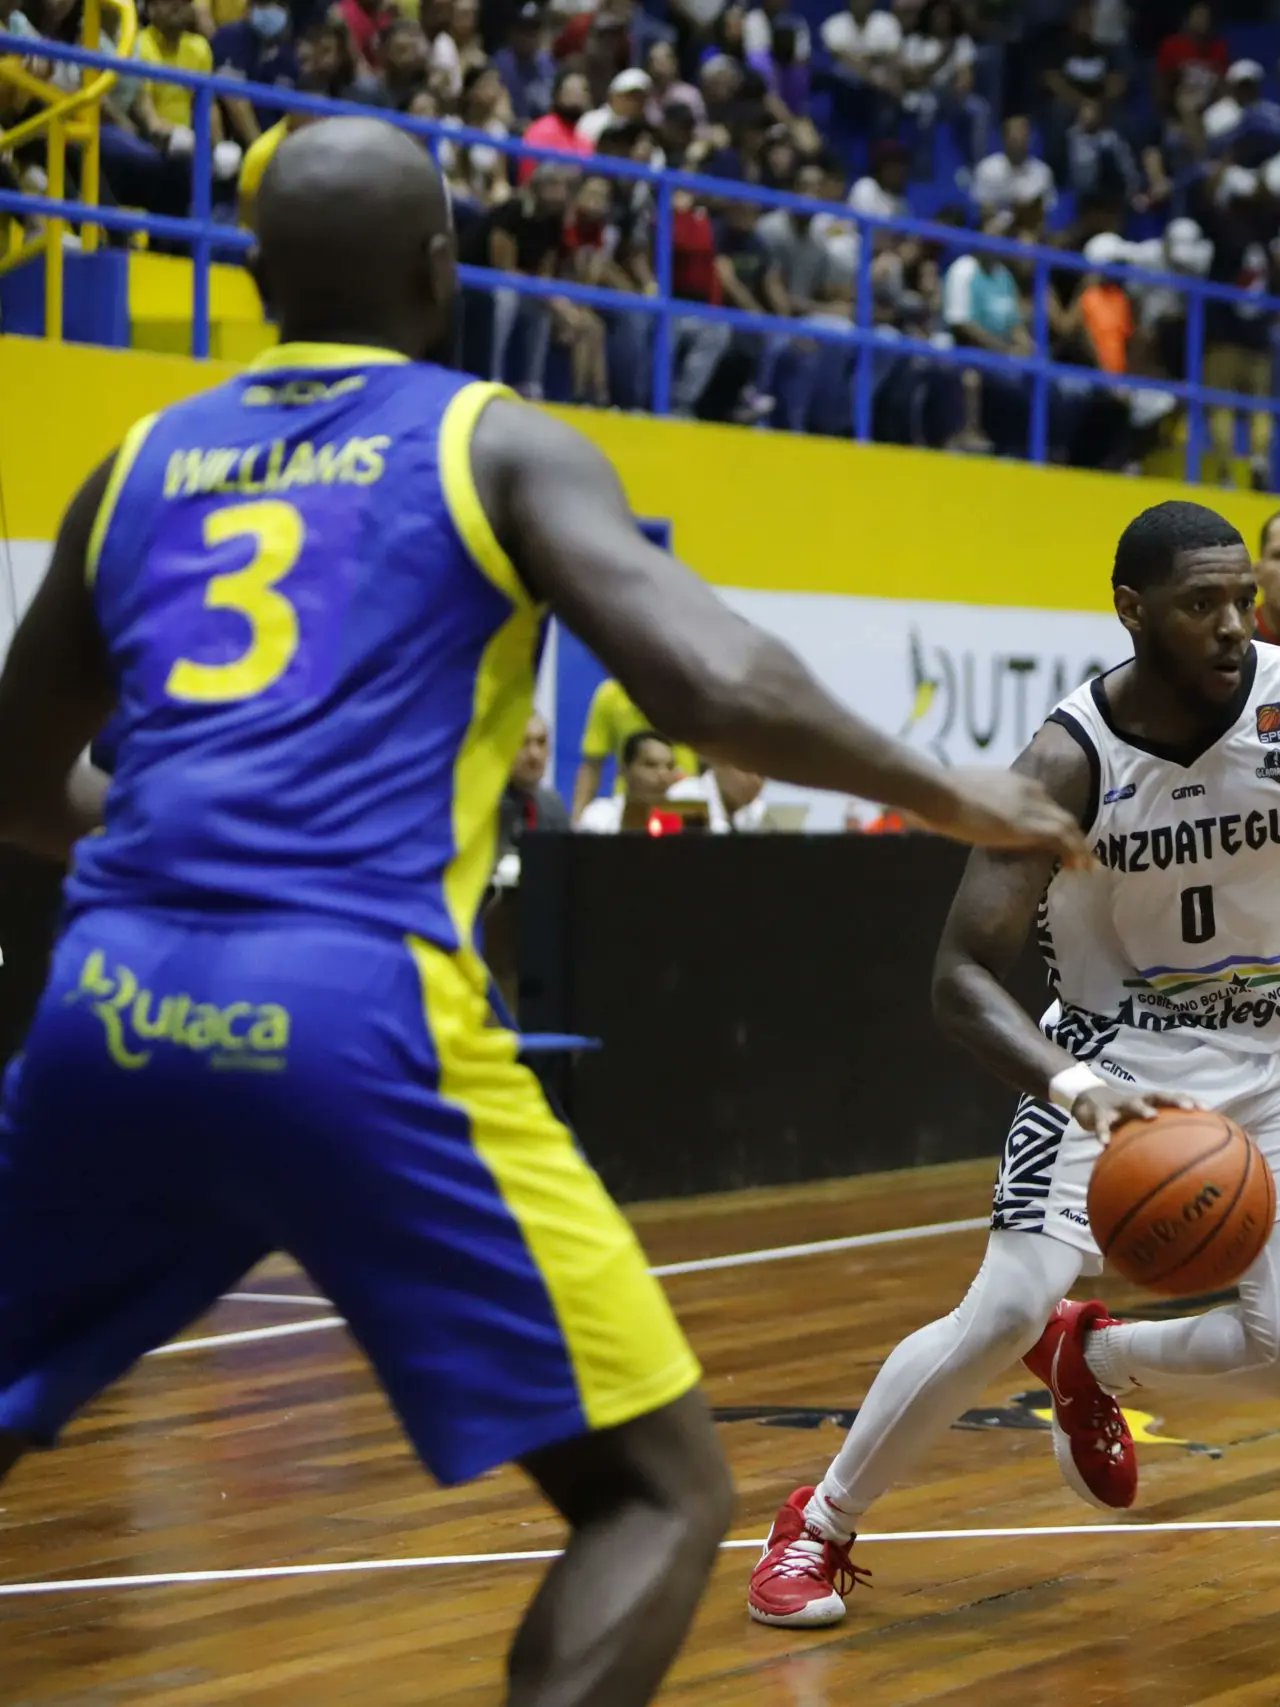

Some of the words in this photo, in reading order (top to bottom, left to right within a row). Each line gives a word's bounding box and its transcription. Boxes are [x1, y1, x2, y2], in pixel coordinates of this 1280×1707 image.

[163, 434, 391, 500] WILLIAMS
[165, 500, 305, 702] 3
[1180, 885, 1216, 944] 0
